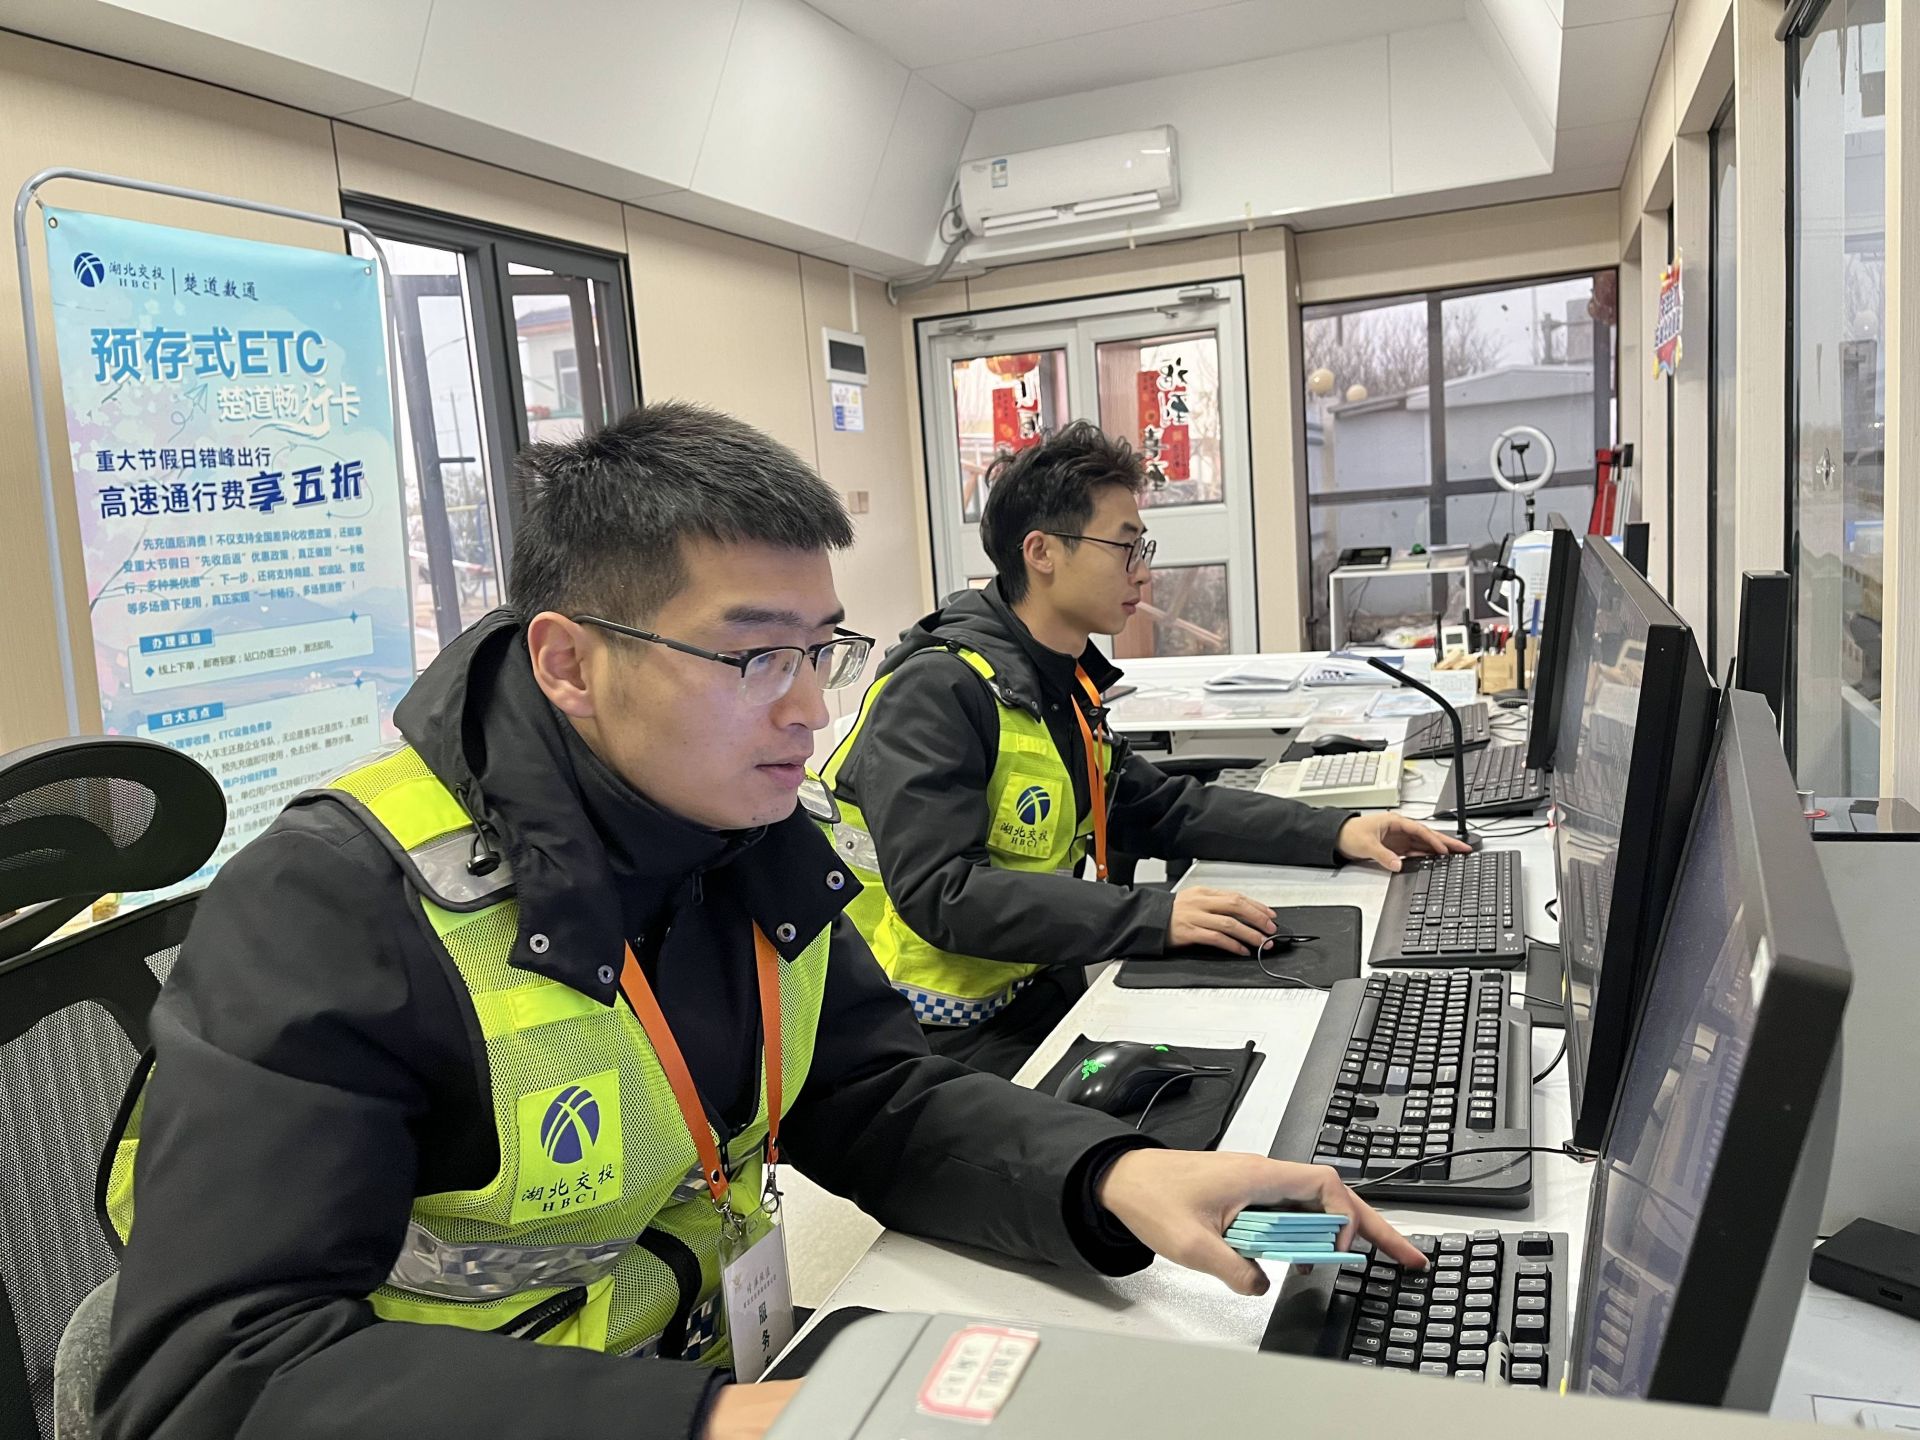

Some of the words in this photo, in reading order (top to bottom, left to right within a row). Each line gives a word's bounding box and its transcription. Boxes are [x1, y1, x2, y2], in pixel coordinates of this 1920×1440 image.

[108, 261, 166, 281] 湖北交投
[183, 272, 260, 301] 楚道数通
[118, 277, 158, 290] HBCI
[90, 325, 327, 384] 预存式ETC
[217, 379, 361, 433] 楚道畅行卡
[96, 446, 272, 473] 重大节假日错峰出行
[98, 459, 365, 520] 高速通行费享五折
[161, 706, 211, 727] 四大亮点
[1000, 822, 1049, 842] 湖北交投
[1011, 837, 1038, 848] HBCI
[521, 1162, 616, 1202] 湖北交投
[541, 1189, 598, 1213] HBCI
